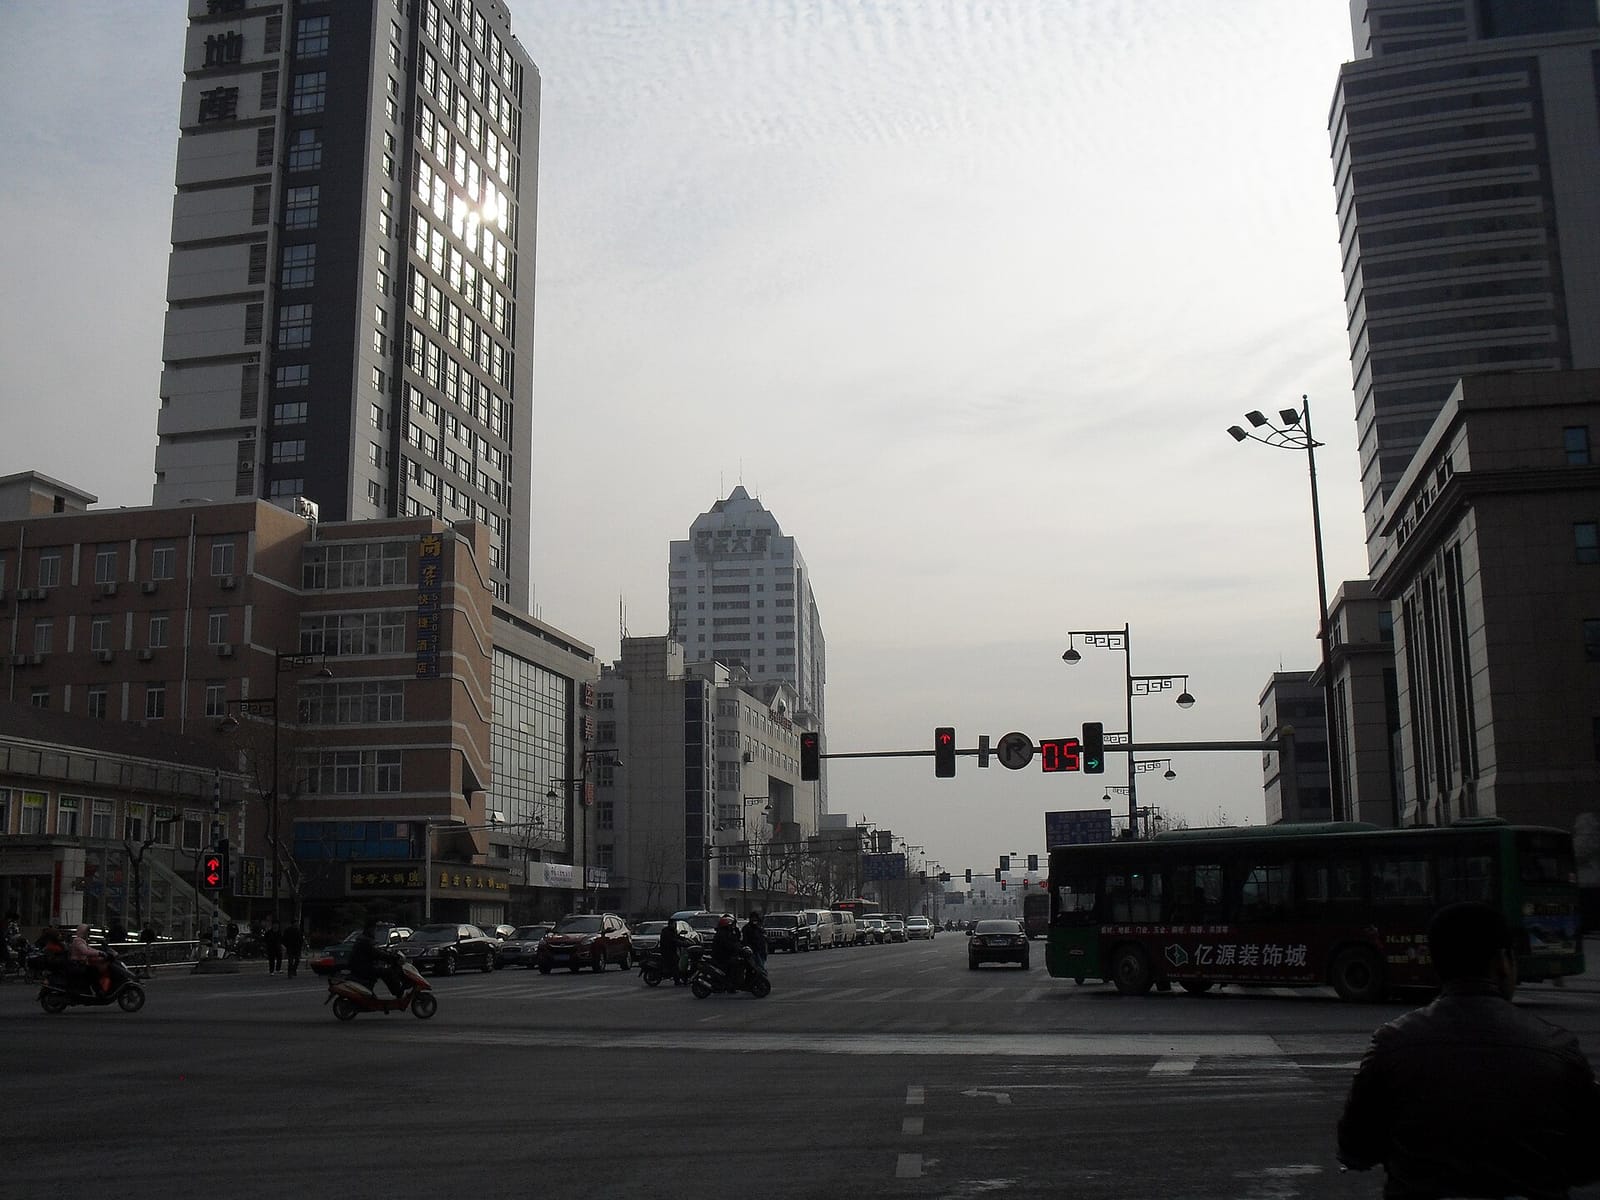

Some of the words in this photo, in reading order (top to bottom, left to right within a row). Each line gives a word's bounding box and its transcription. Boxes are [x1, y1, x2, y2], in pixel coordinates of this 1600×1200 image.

[1042, 741, 1079, 771] 05
[1194, 943, 1308, 967] 亿源装饰城
